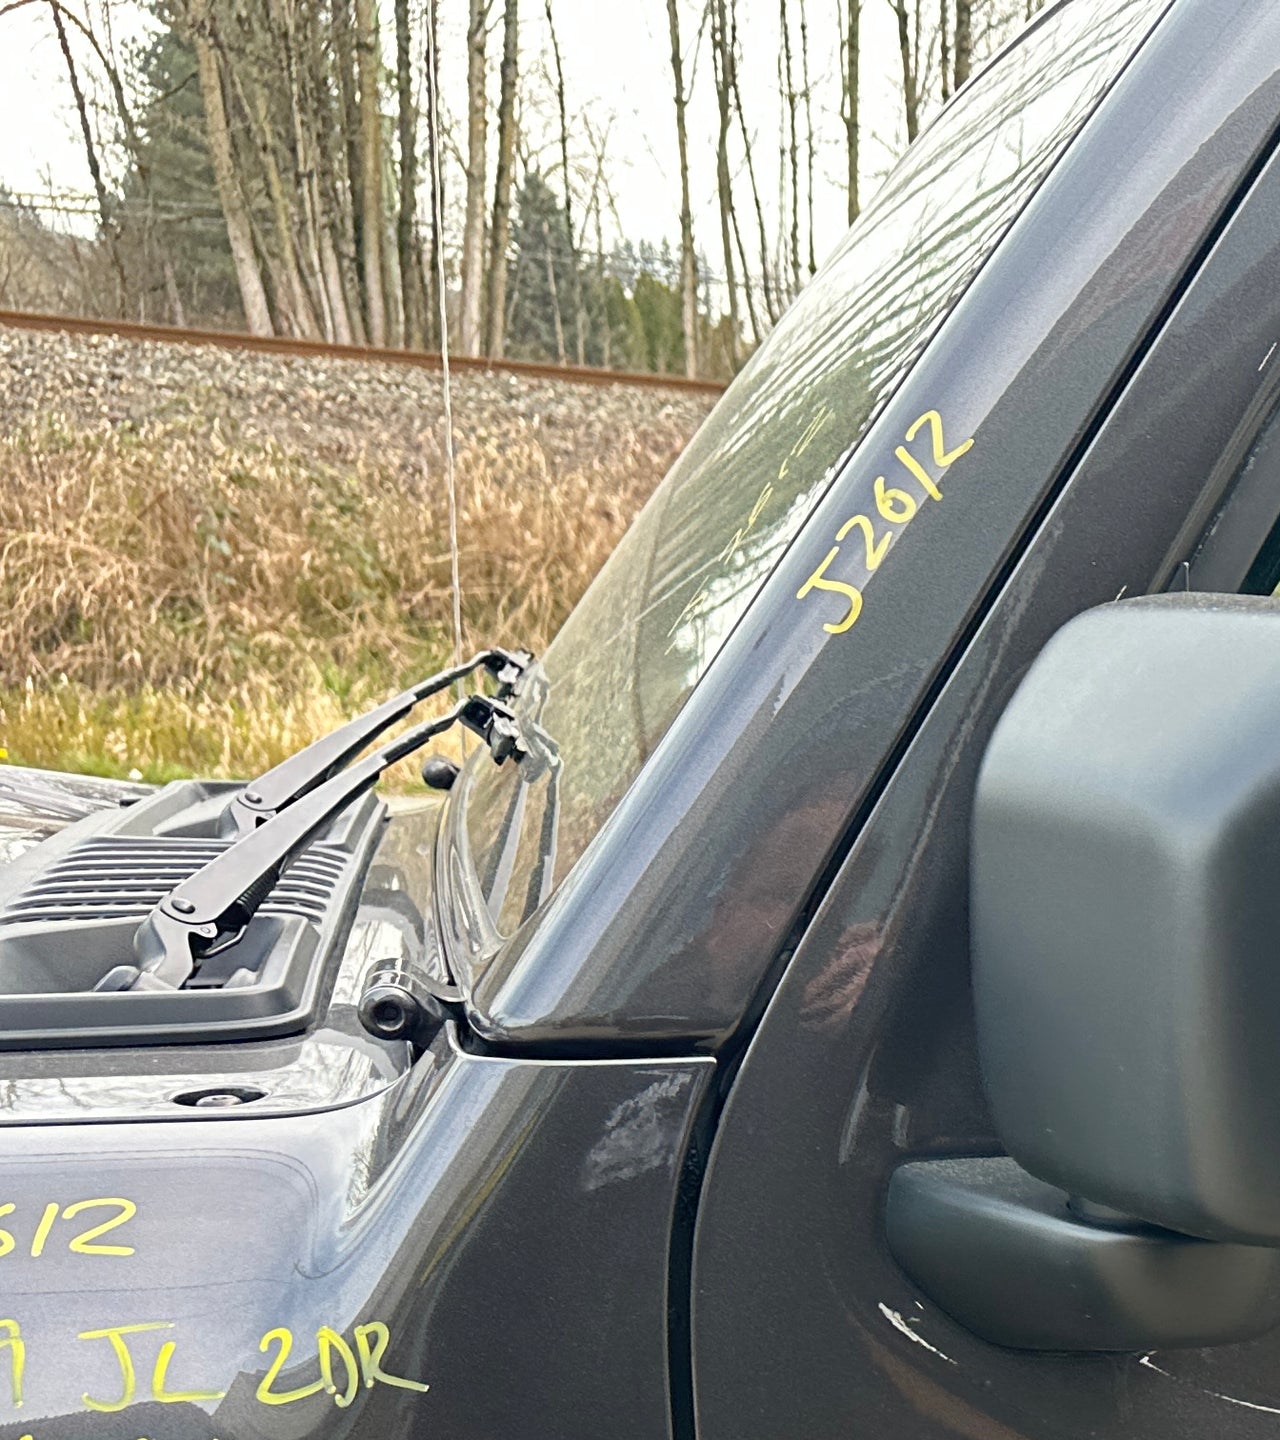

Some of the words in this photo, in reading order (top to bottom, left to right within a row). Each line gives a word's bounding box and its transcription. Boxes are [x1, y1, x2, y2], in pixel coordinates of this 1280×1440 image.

[796, 410, 975, 633] J2612
[77, 1321, 226, 1413] JL
[255, 1321, 430, 1409] 2DR
